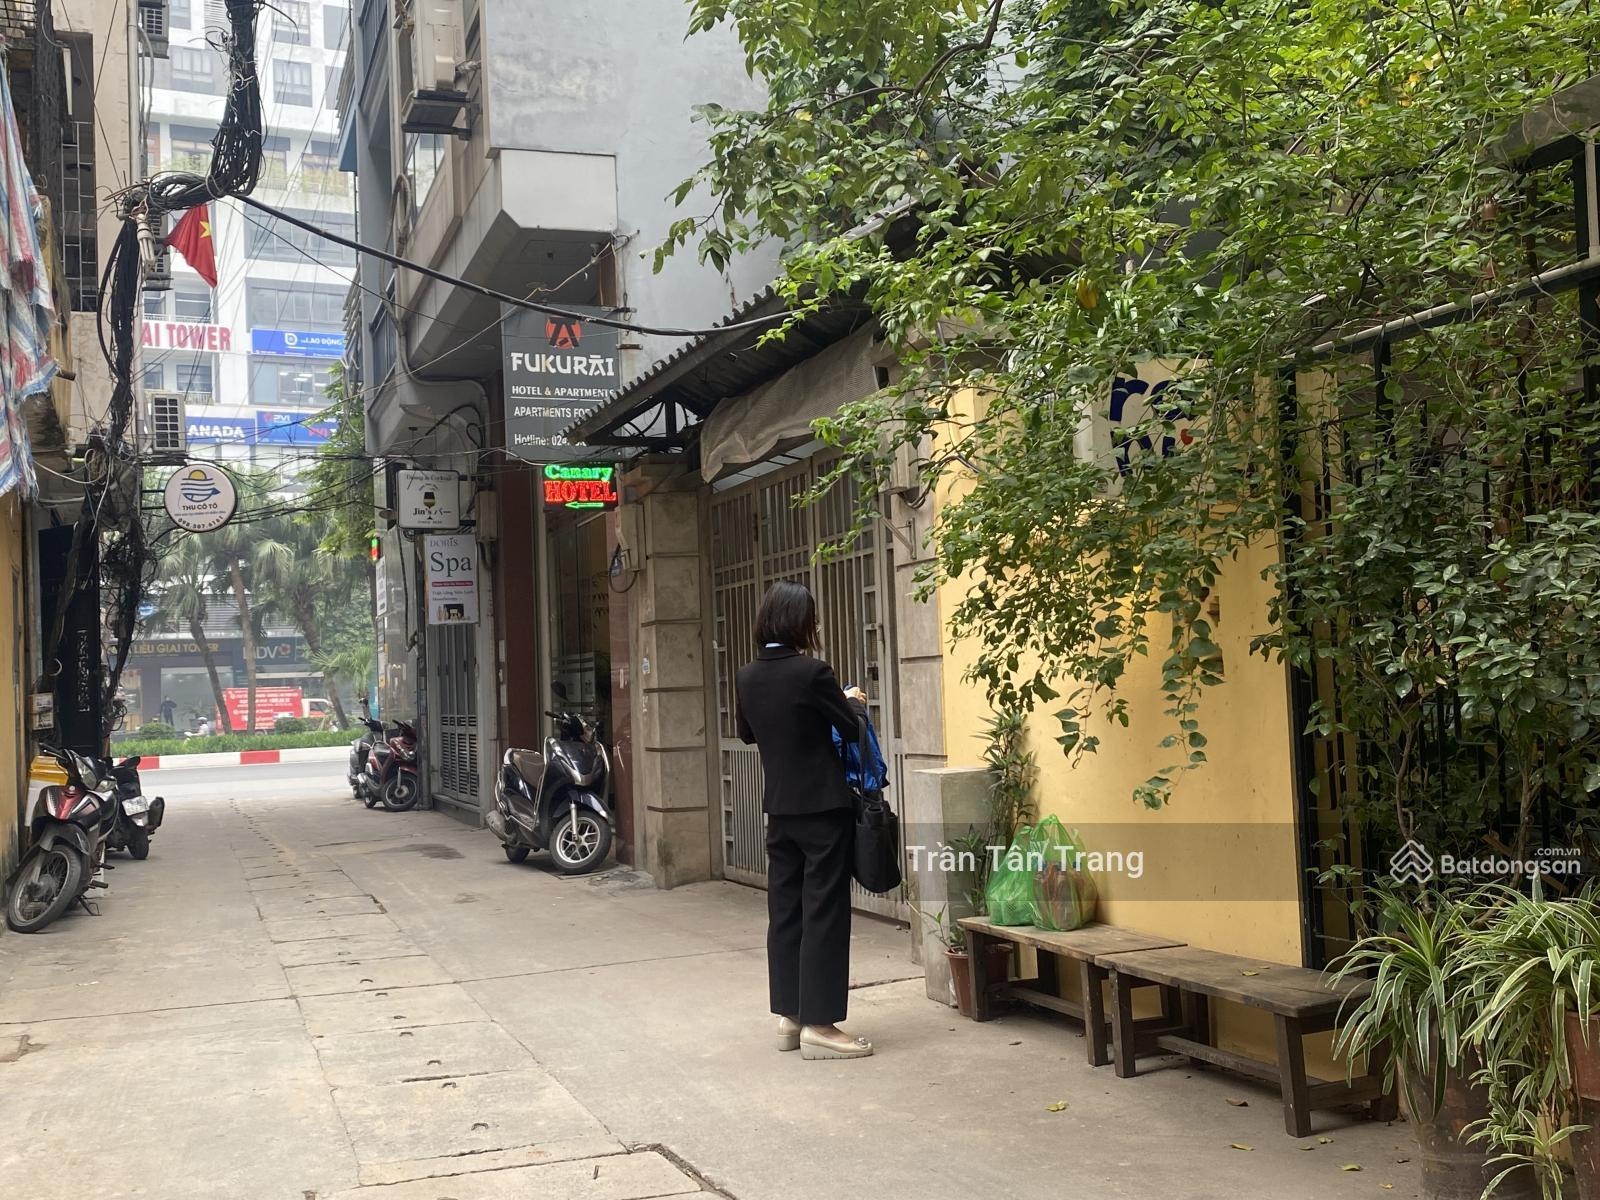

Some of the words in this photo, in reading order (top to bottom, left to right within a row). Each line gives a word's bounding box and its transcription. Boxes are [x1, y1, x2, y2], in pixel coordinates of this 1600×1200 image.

[166, 324, 231, 351] TOWER
[512, 385, 542, 396] HOTEL
[544, 386, 552, 396] &
[554, 387, 616, 398] APARTMENTS
[514, 406, 572, 418] APARTMENTS
[514, 433, 549, 446] Hotline:
[545, 463, 614, 482] Canary
[544, 480, 616, 502] HOTEL
[430, 551, 473, 578] Spa
